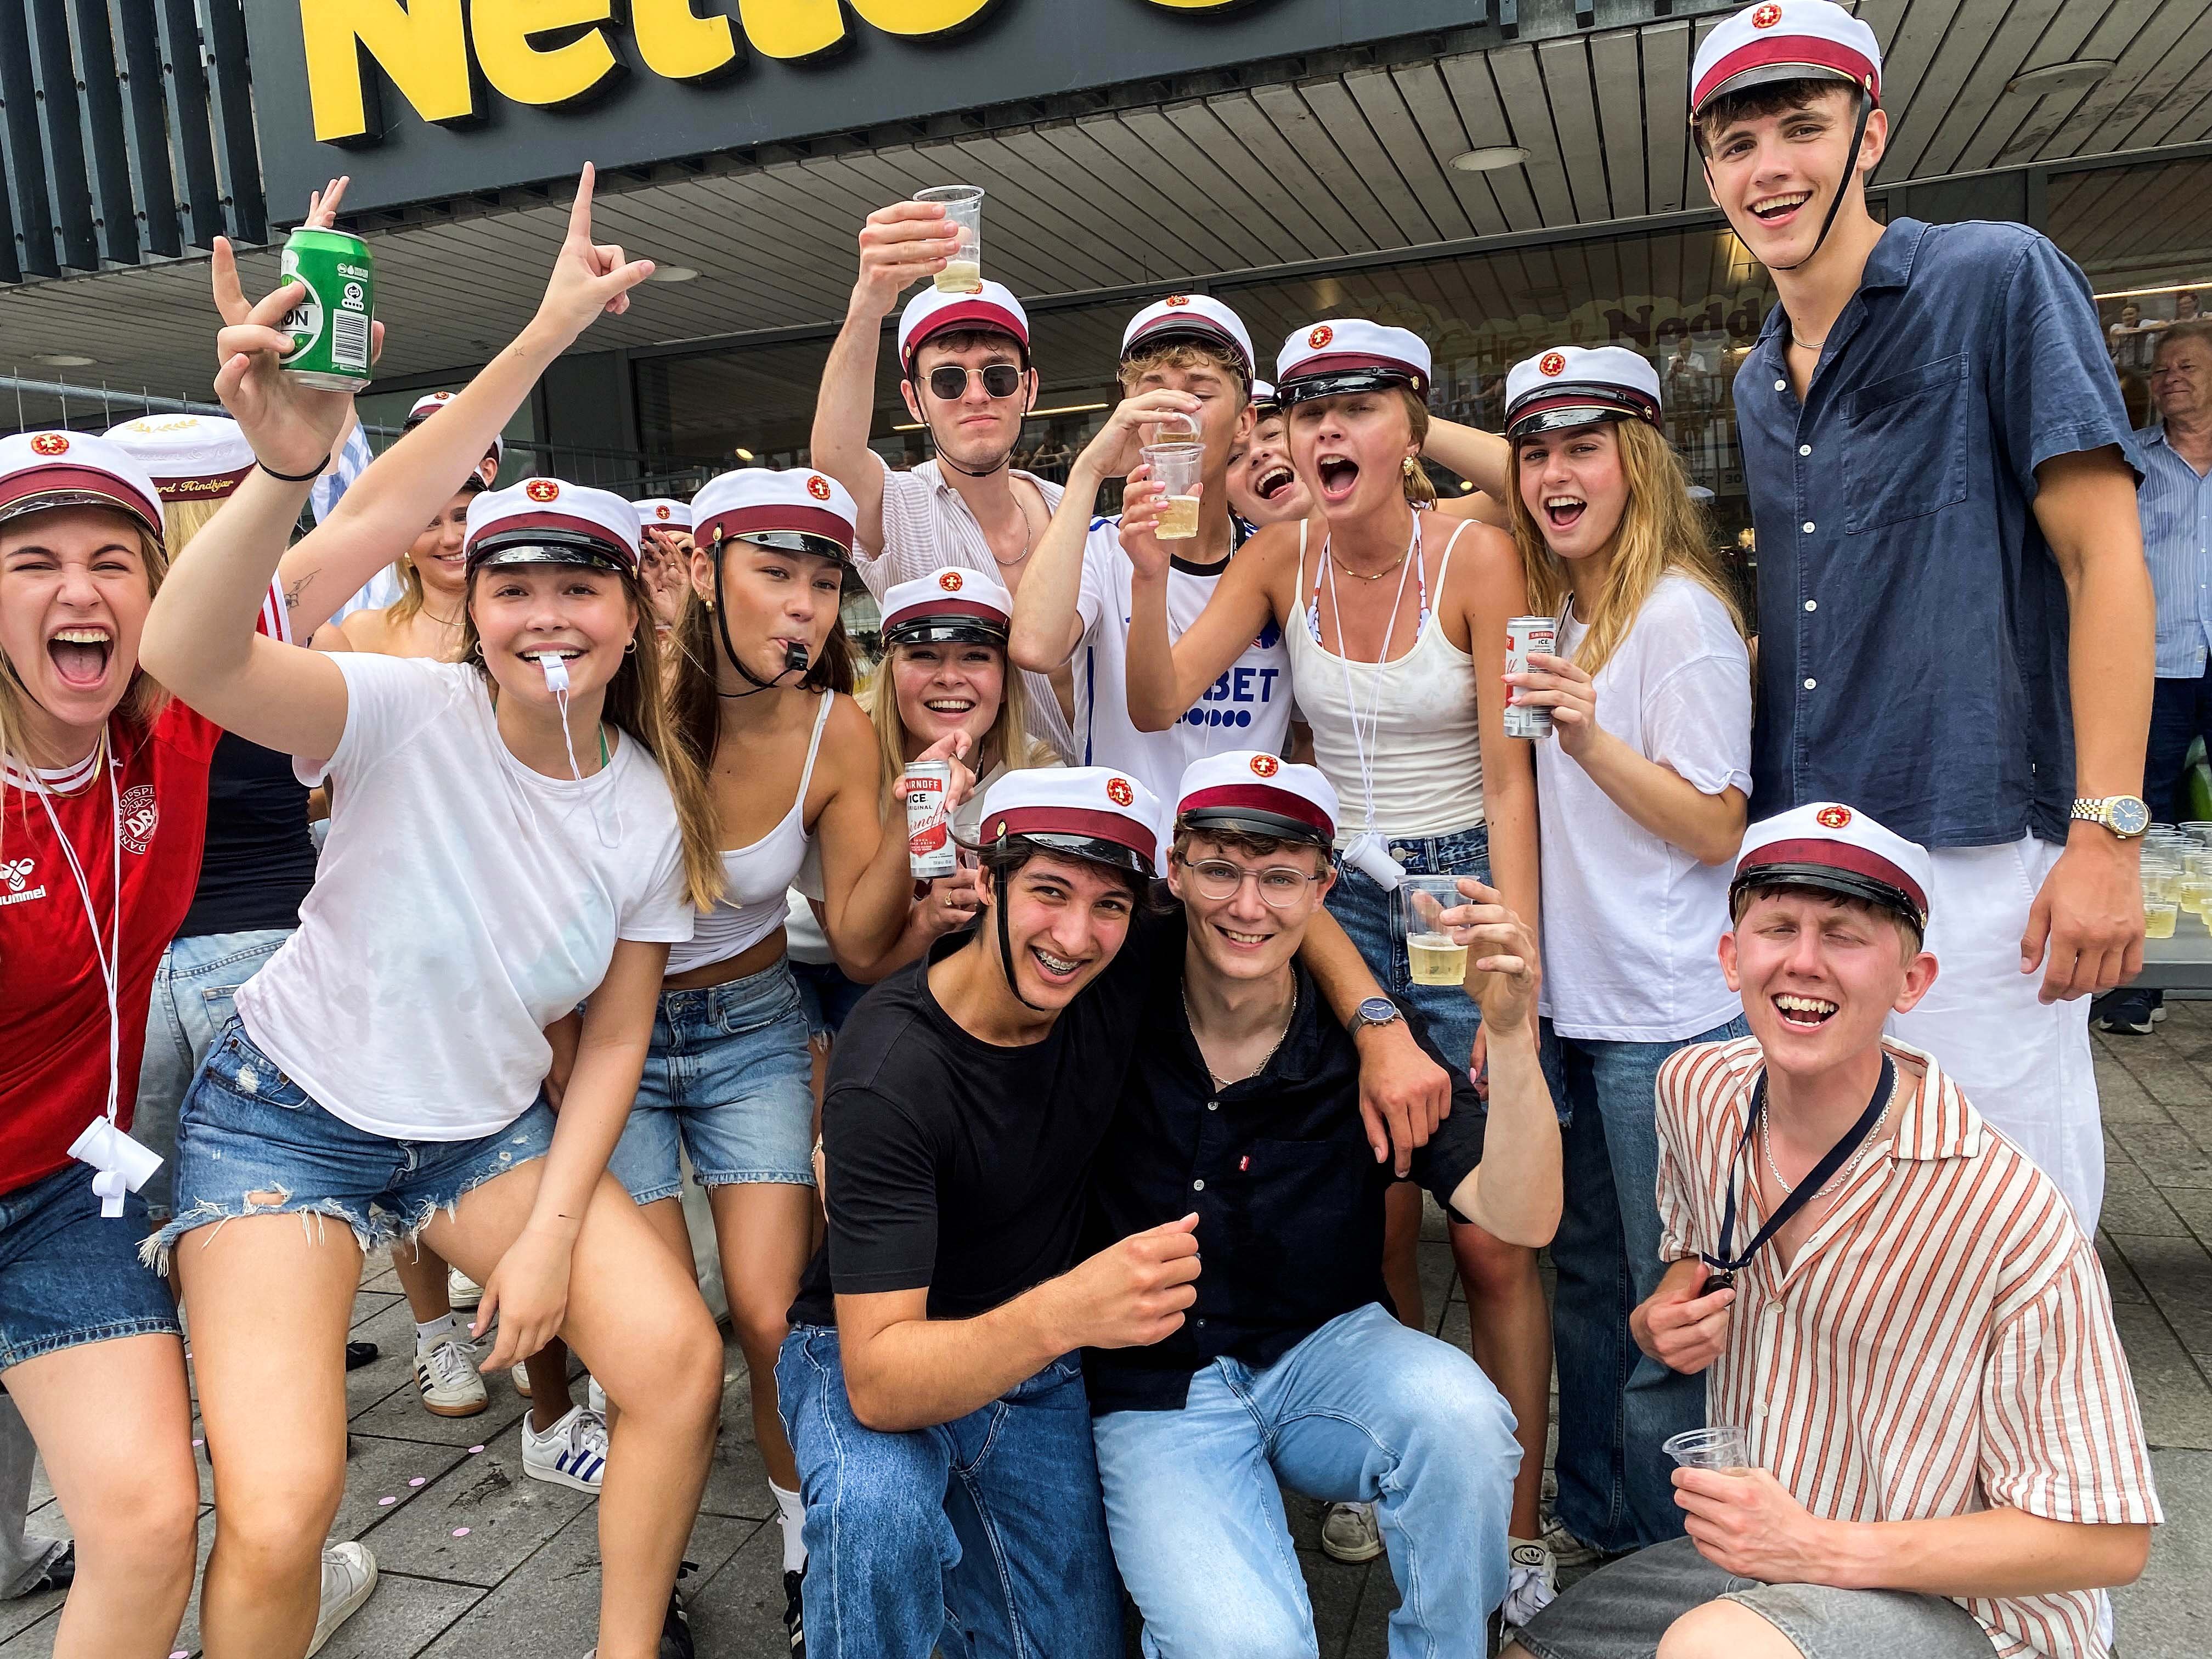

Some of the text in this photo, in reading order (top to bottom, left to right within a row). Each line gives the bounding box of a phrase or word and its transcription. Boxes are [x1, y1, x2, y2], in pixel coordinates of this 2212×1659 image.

[281, 309, 308, 326] ØN
[909, 793, 927, 804] ICE
[119, 820, 146, 852] DANS
